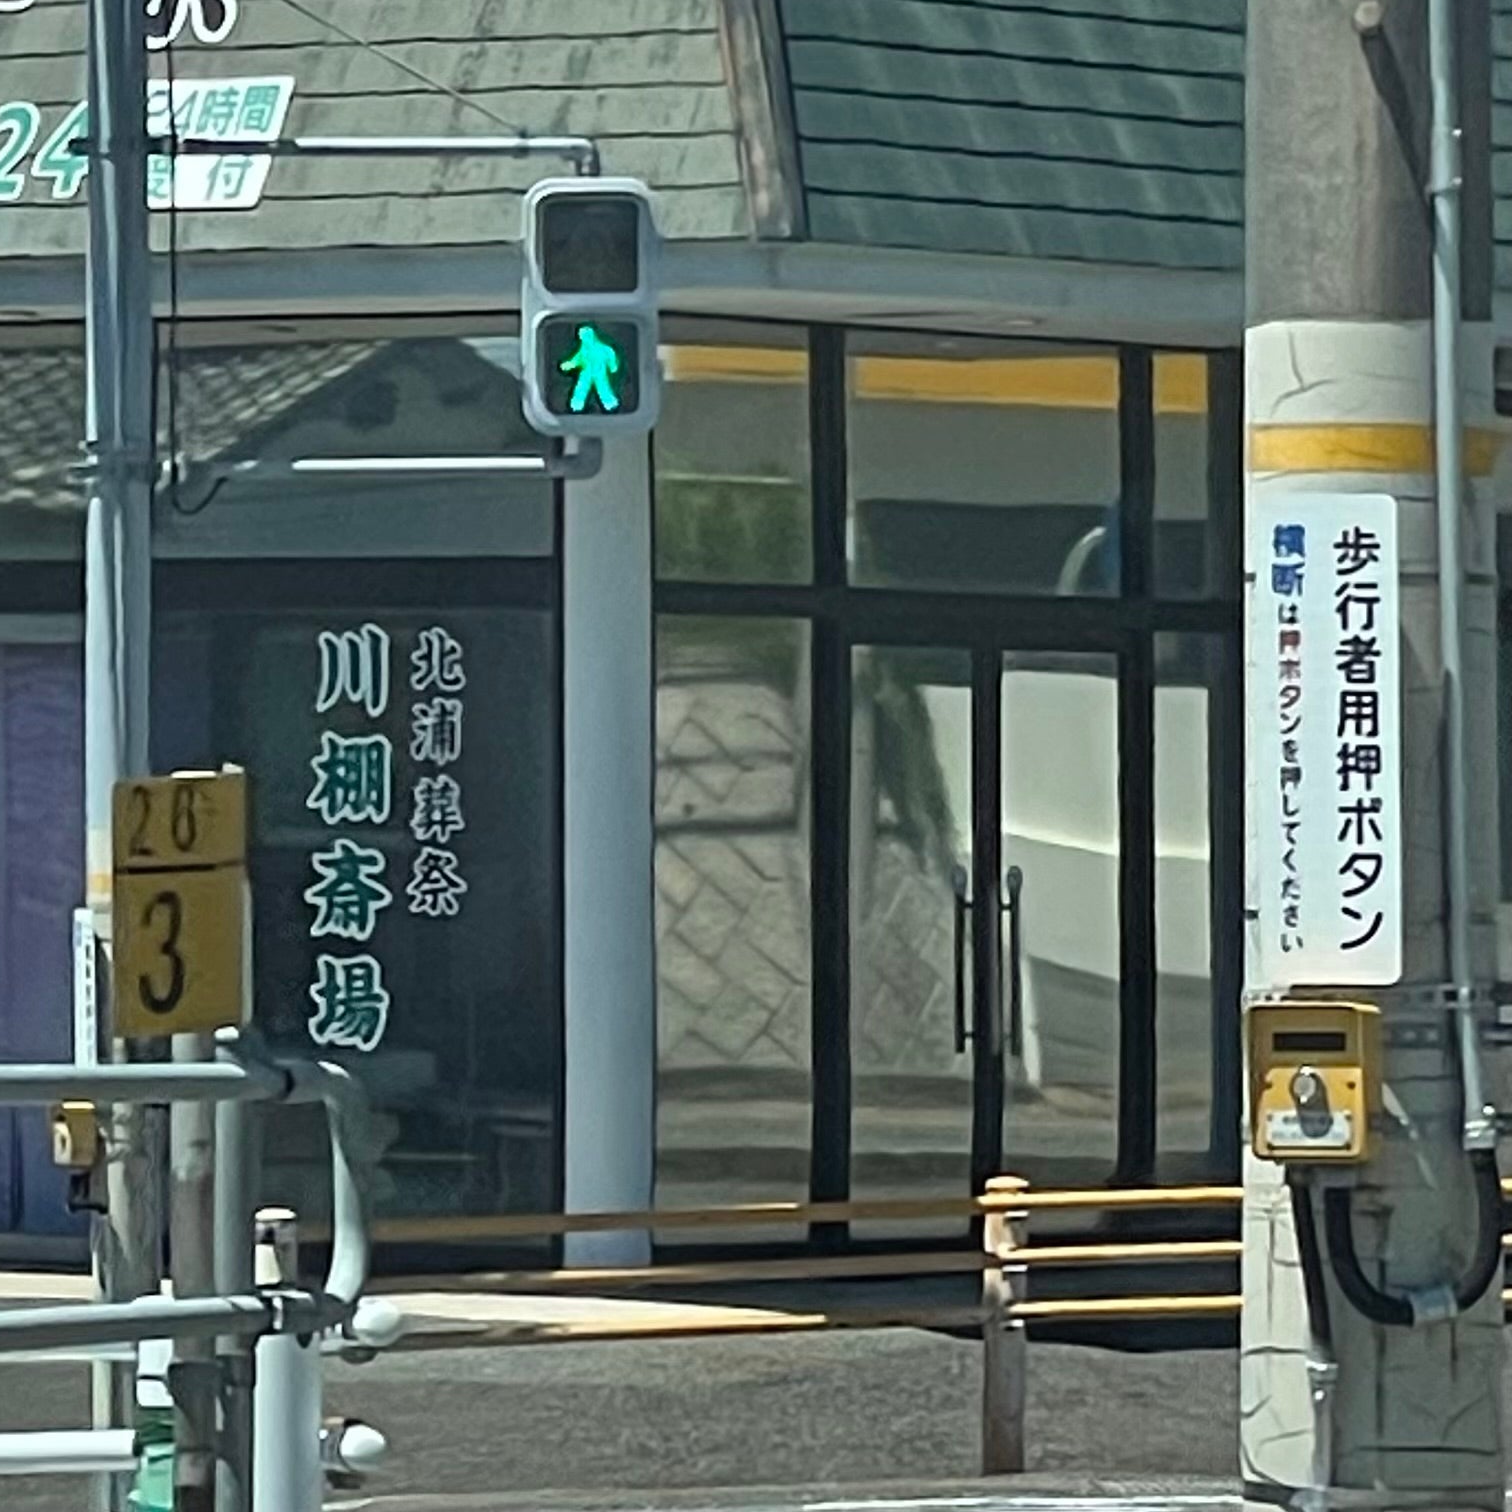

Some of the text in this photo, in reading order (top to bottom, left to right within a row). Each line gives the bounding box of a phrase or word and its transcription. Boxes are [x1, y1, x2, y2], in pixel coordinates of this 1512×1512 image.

[305, 623, 392, 1052] 川棚斎場
[408, 627, 467, 916] 北浦葬祭
[1333, 525, 1384, 950] 歩行者用押ボタン
[140, 890, 184, 1015] 3
